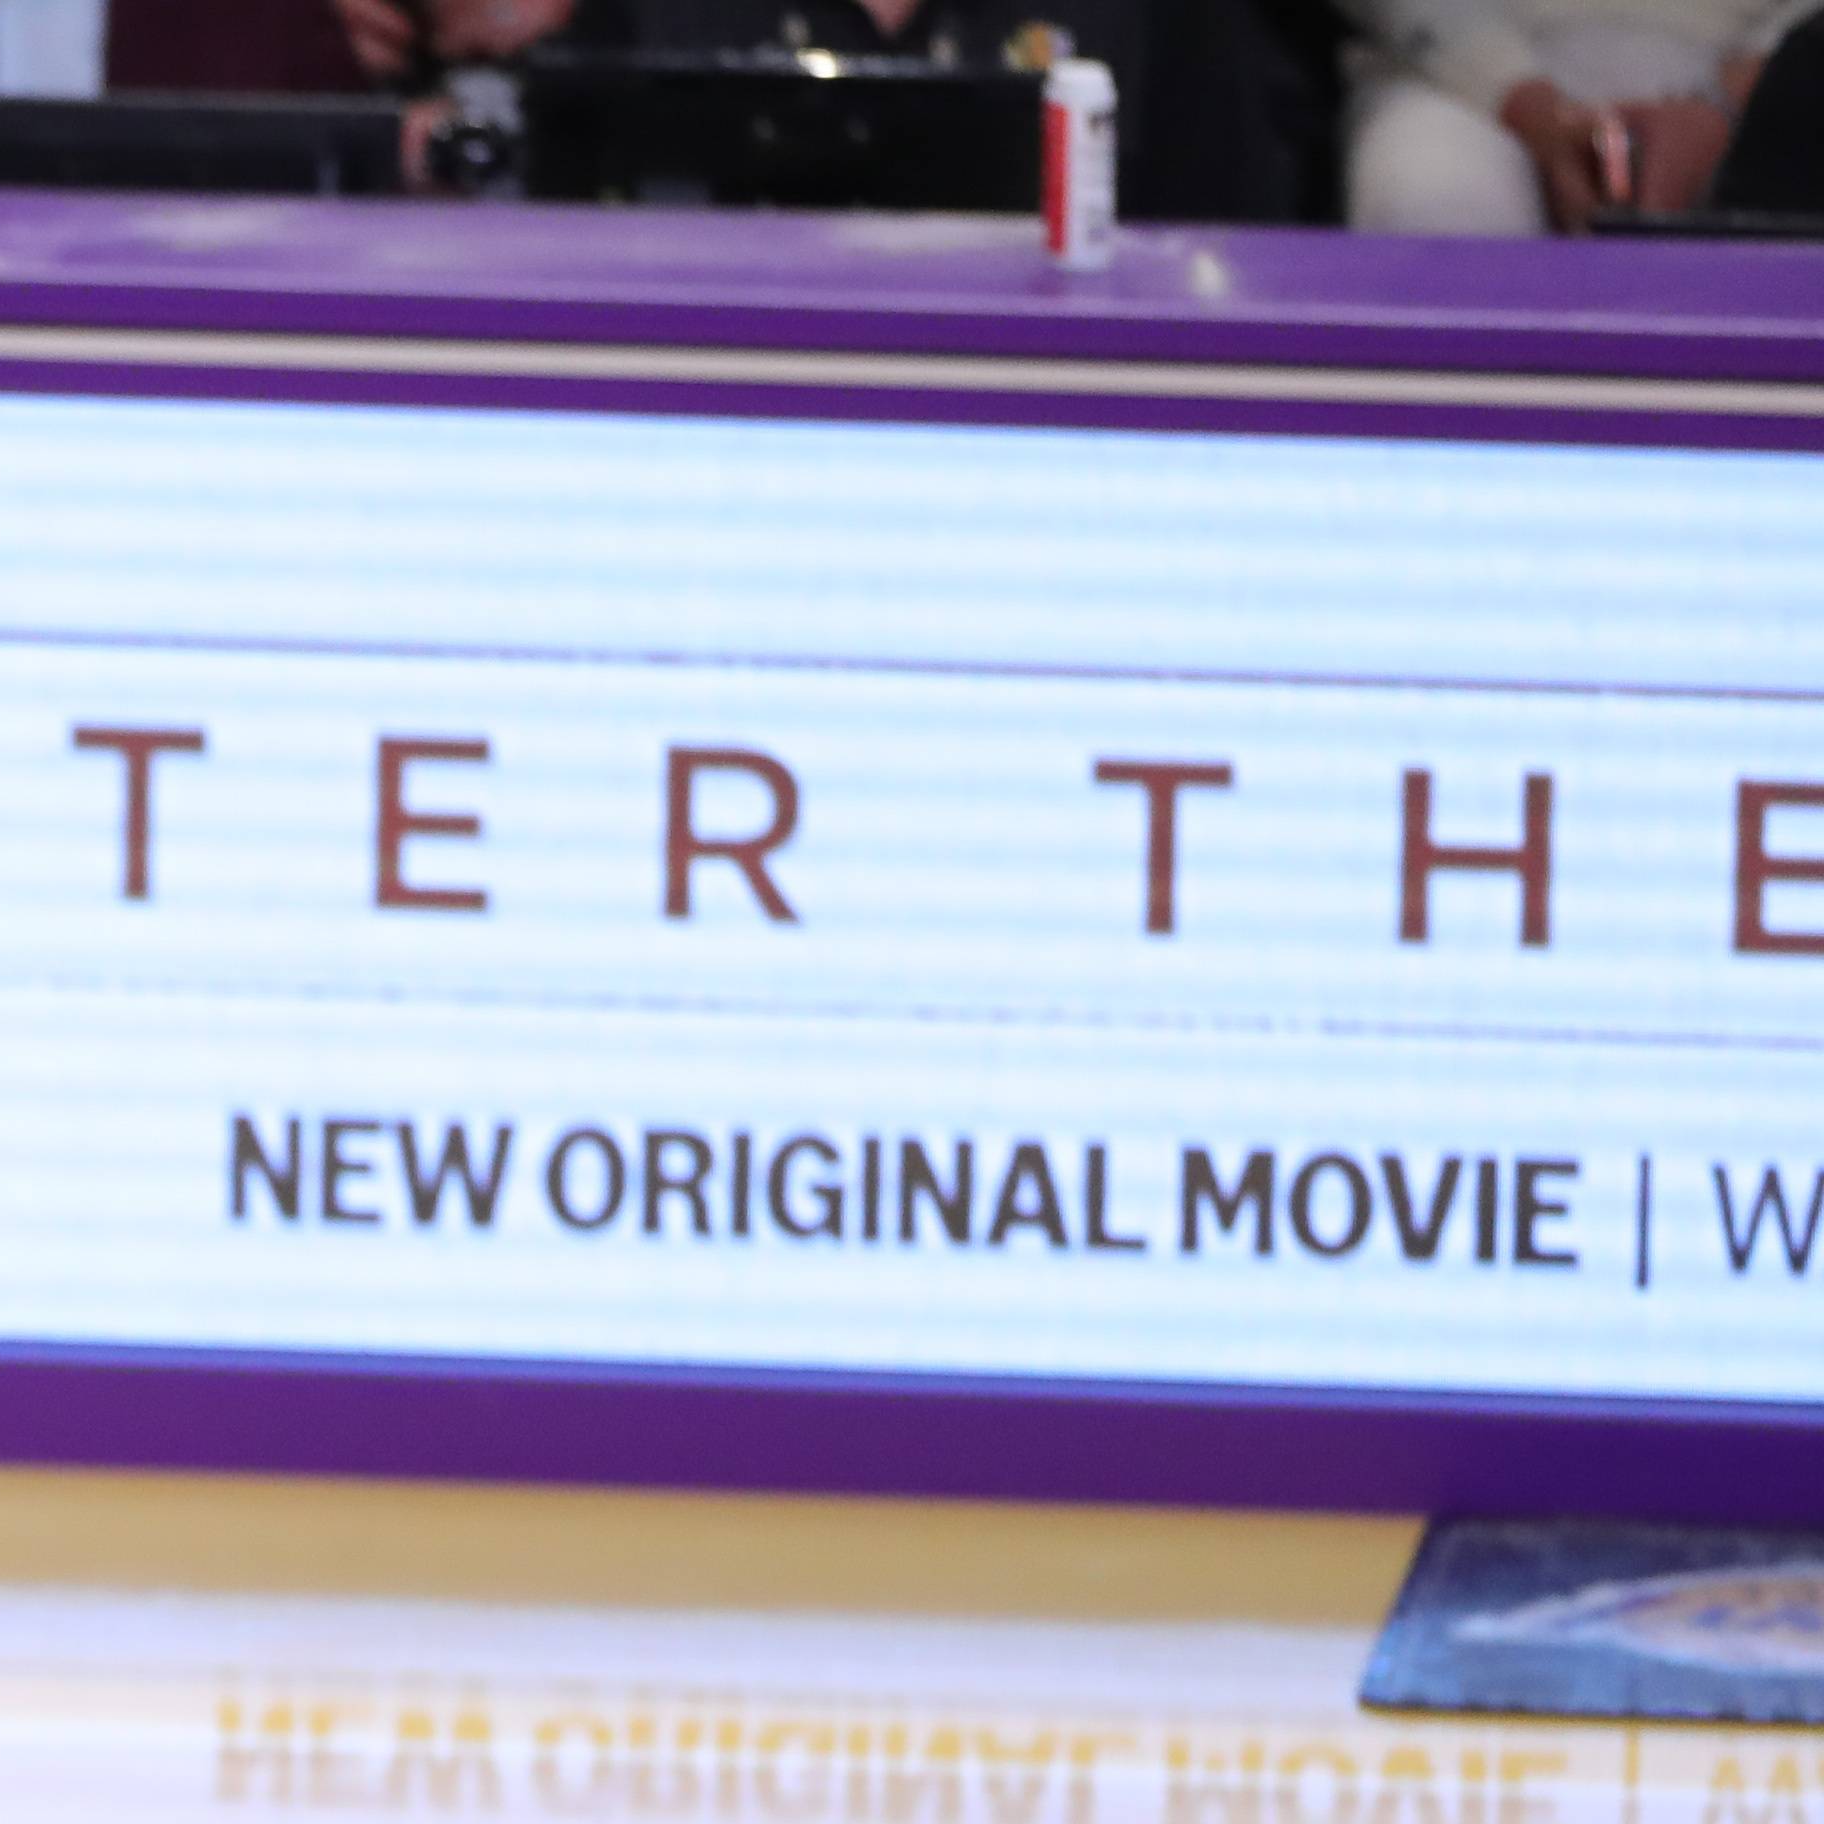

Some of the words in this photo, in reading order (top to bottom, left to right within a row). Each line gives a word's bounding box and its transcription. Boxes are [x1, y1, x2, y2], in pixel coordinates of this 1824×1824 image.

[1092, 757, 1824, 959] THE
[229, 1114, 515, 1229] NEW
[544, 1125, 1148, 1254] ORIGINAL
[1178, 1145, 1581, 1269] MOVIE
